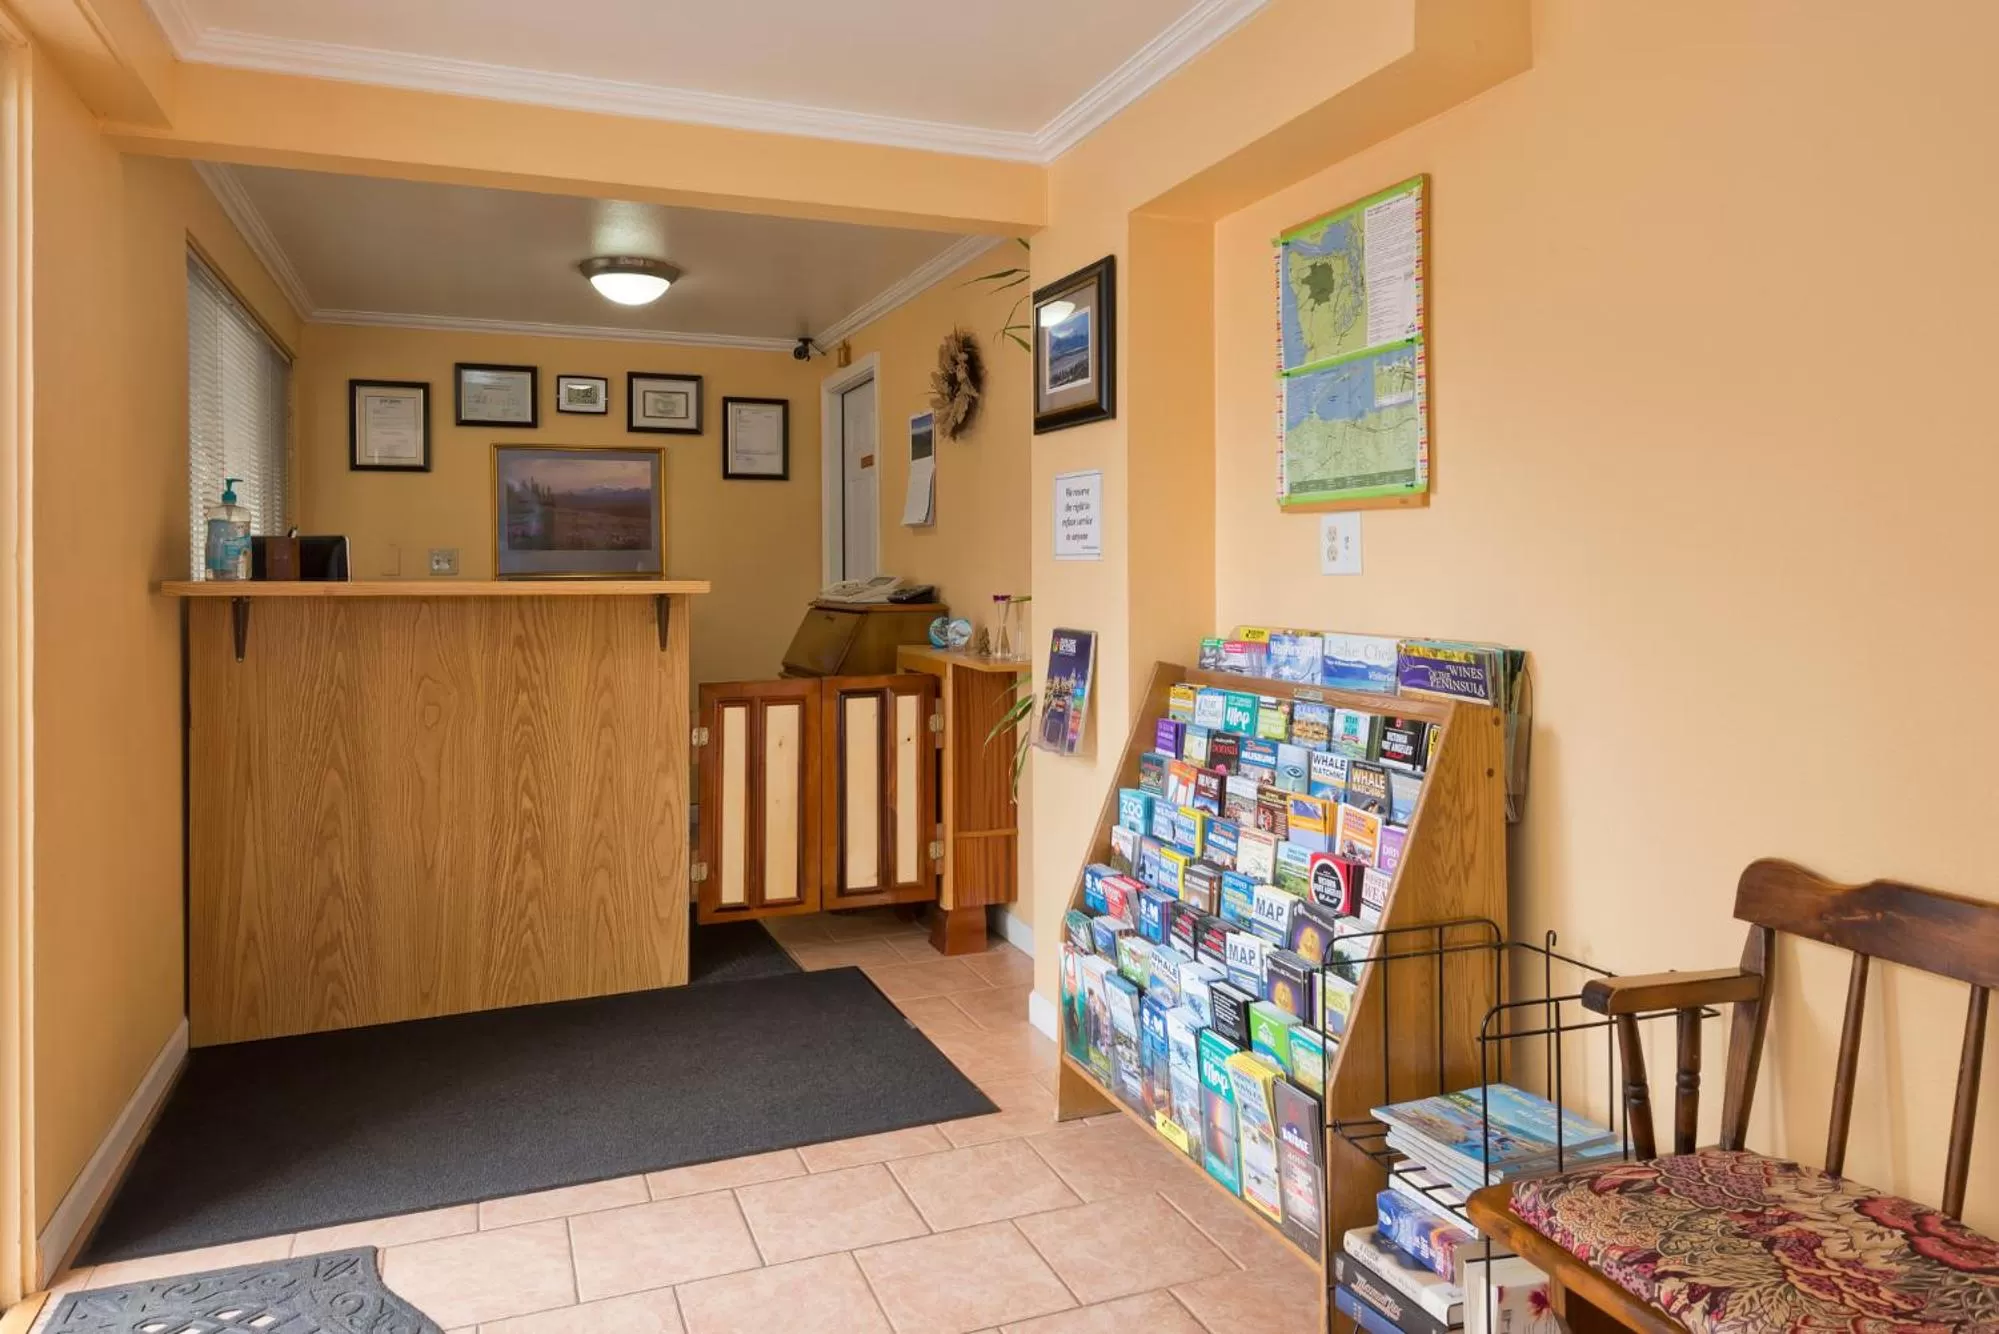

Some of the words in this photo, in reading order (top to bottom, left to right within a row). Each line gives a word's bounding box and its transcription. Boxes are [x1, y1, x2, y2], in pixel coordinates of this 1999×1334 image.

[1449, 664, 1483, 680] WINES
[1430, 679, 1486, 698] PENINSULA
[1311, 751, 1346, 771] WHALE
[1352, 767, 1386, 790] WHALE
[1255, 897, 1285, 922] MAP
[1229, 943, 1257, 966] MAP
